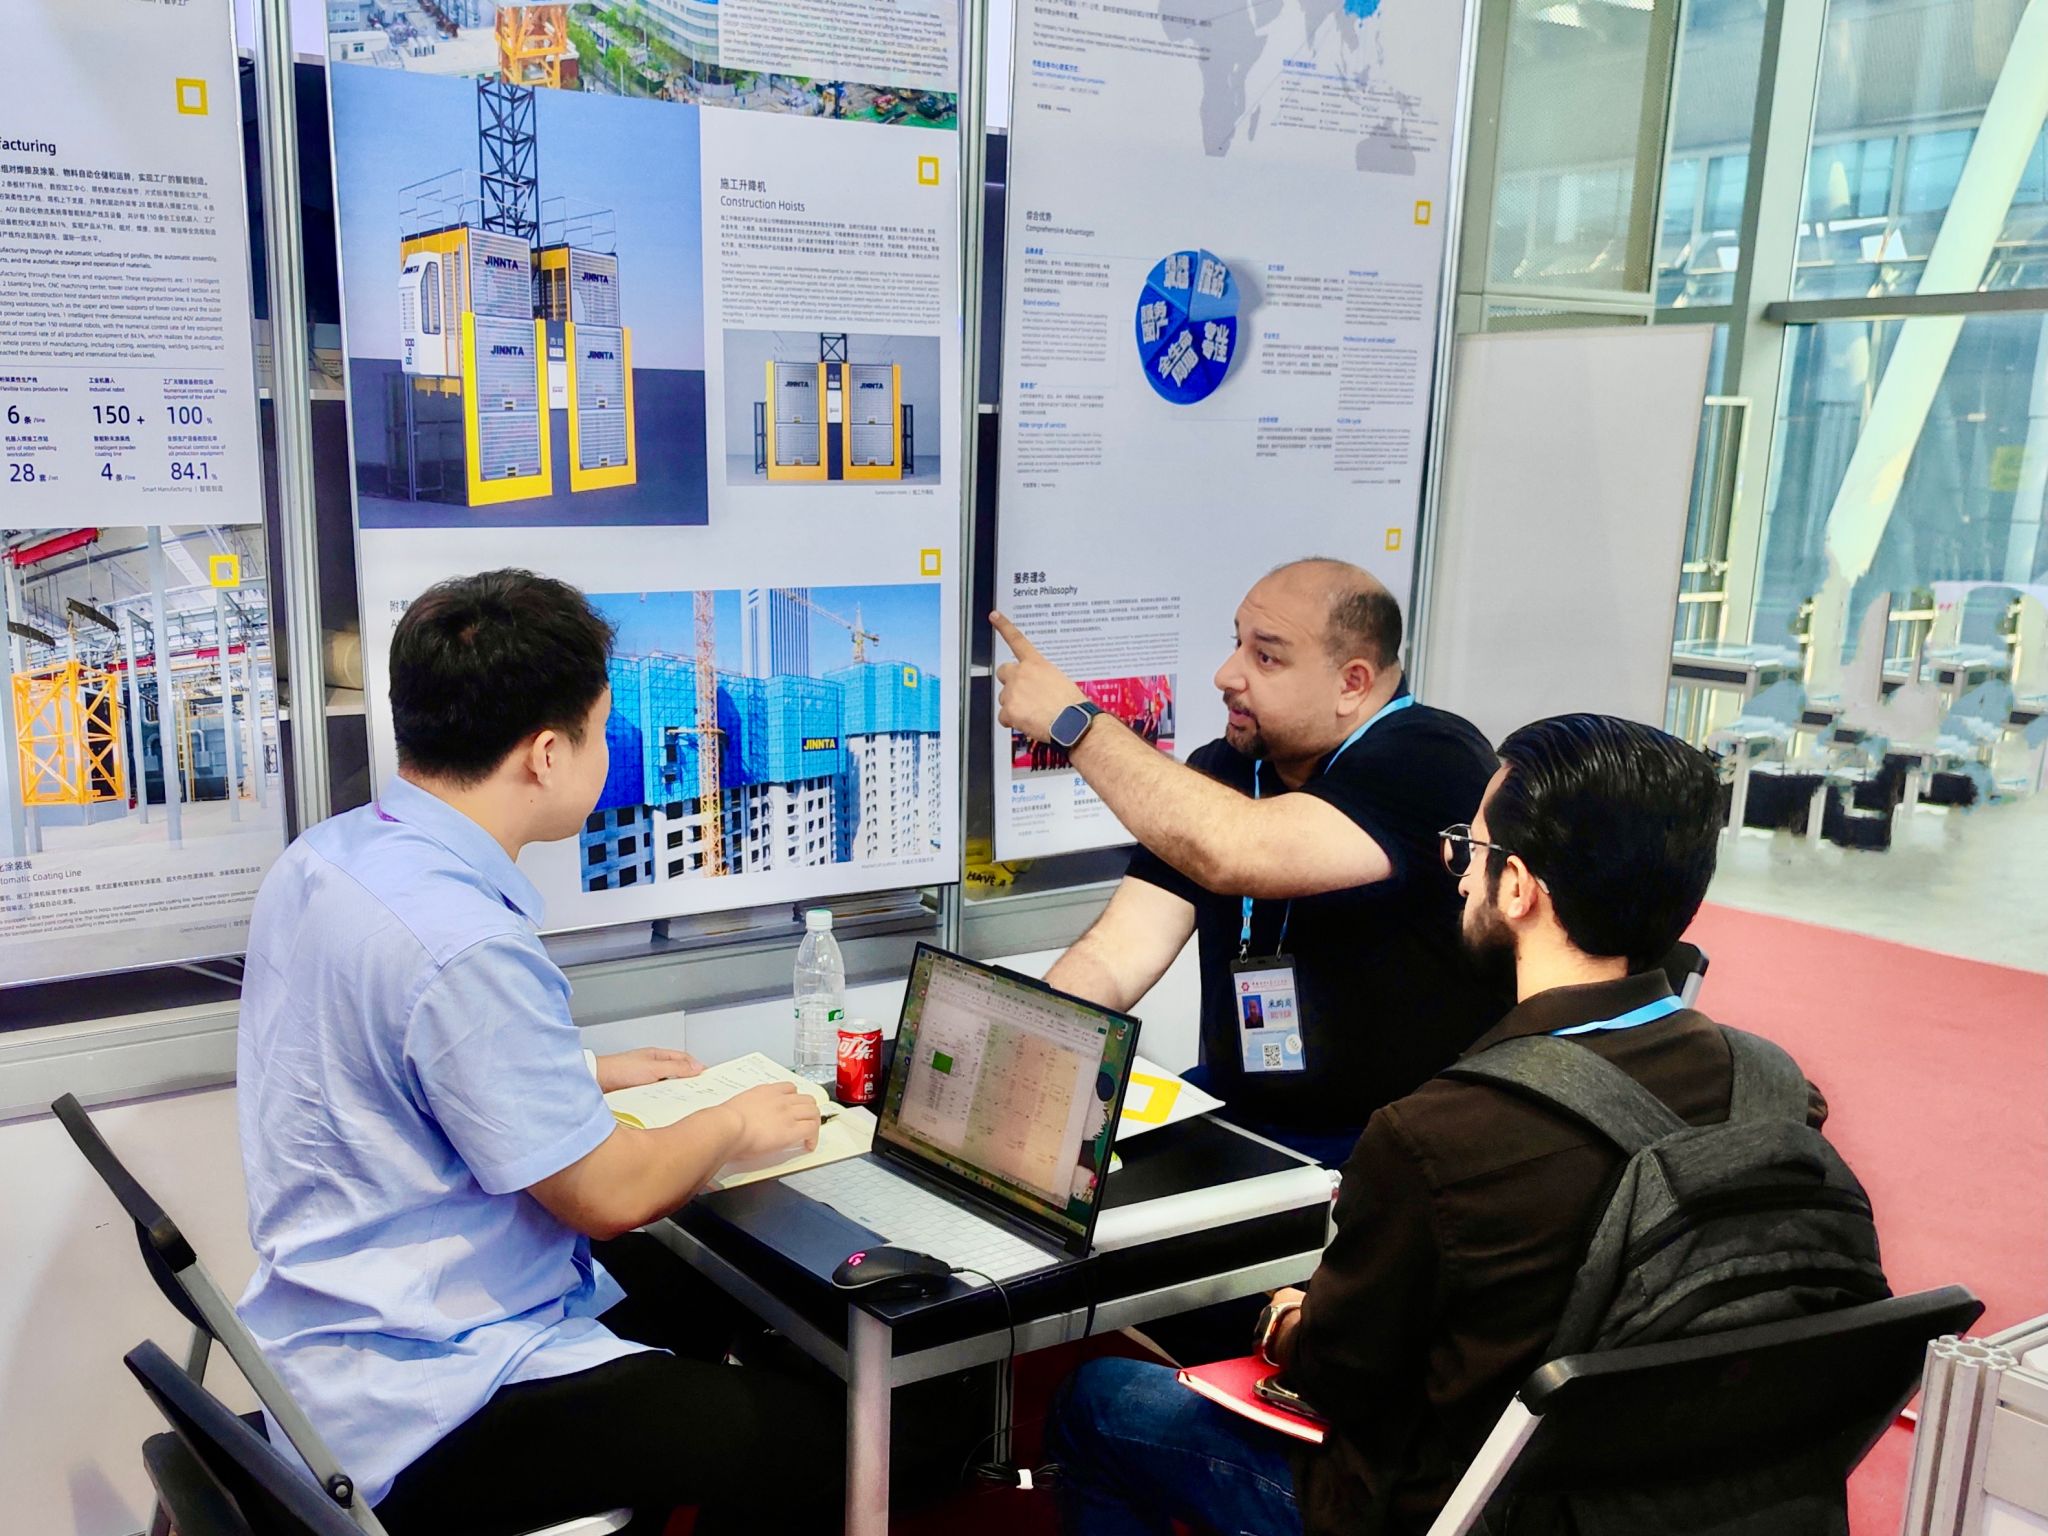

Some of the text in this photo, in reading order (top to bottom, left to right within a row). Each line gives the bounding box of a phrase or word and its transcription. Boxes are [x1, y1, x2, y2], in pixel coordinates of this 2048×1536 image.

[720, 177, 766, 192] 施工升降机
[720, 195, 804, 211] Construction Hoists
[30, 248, 51, 256] through
[93, 260, 118, 268] operation
[484, 256, 518, 270] JINNTA
[582, 272, 608, 284] JINNTA
[490, 344, 524, 356] JINNTA
[587, 350, 614, 360] JINNTA
[7, 404, 19, 423] 6
[92, 405, 144, 424] 150 +
[166, 406, 202, 424] 100
[10, 463, 35, 482] 28
[101, 462, 112, 480] 4
[170, 462, 208, 480] 84.1
[1014, 571, 1045, 584] 服务理念
[1013, 585, 1077, 597] Service Philosophy
[804, 738, 836, 750] JINNTA
[32, 870, 63, 882] Coating
[65, 869, 81, 878] Line
[967, 871, 996, 886] HAVE
